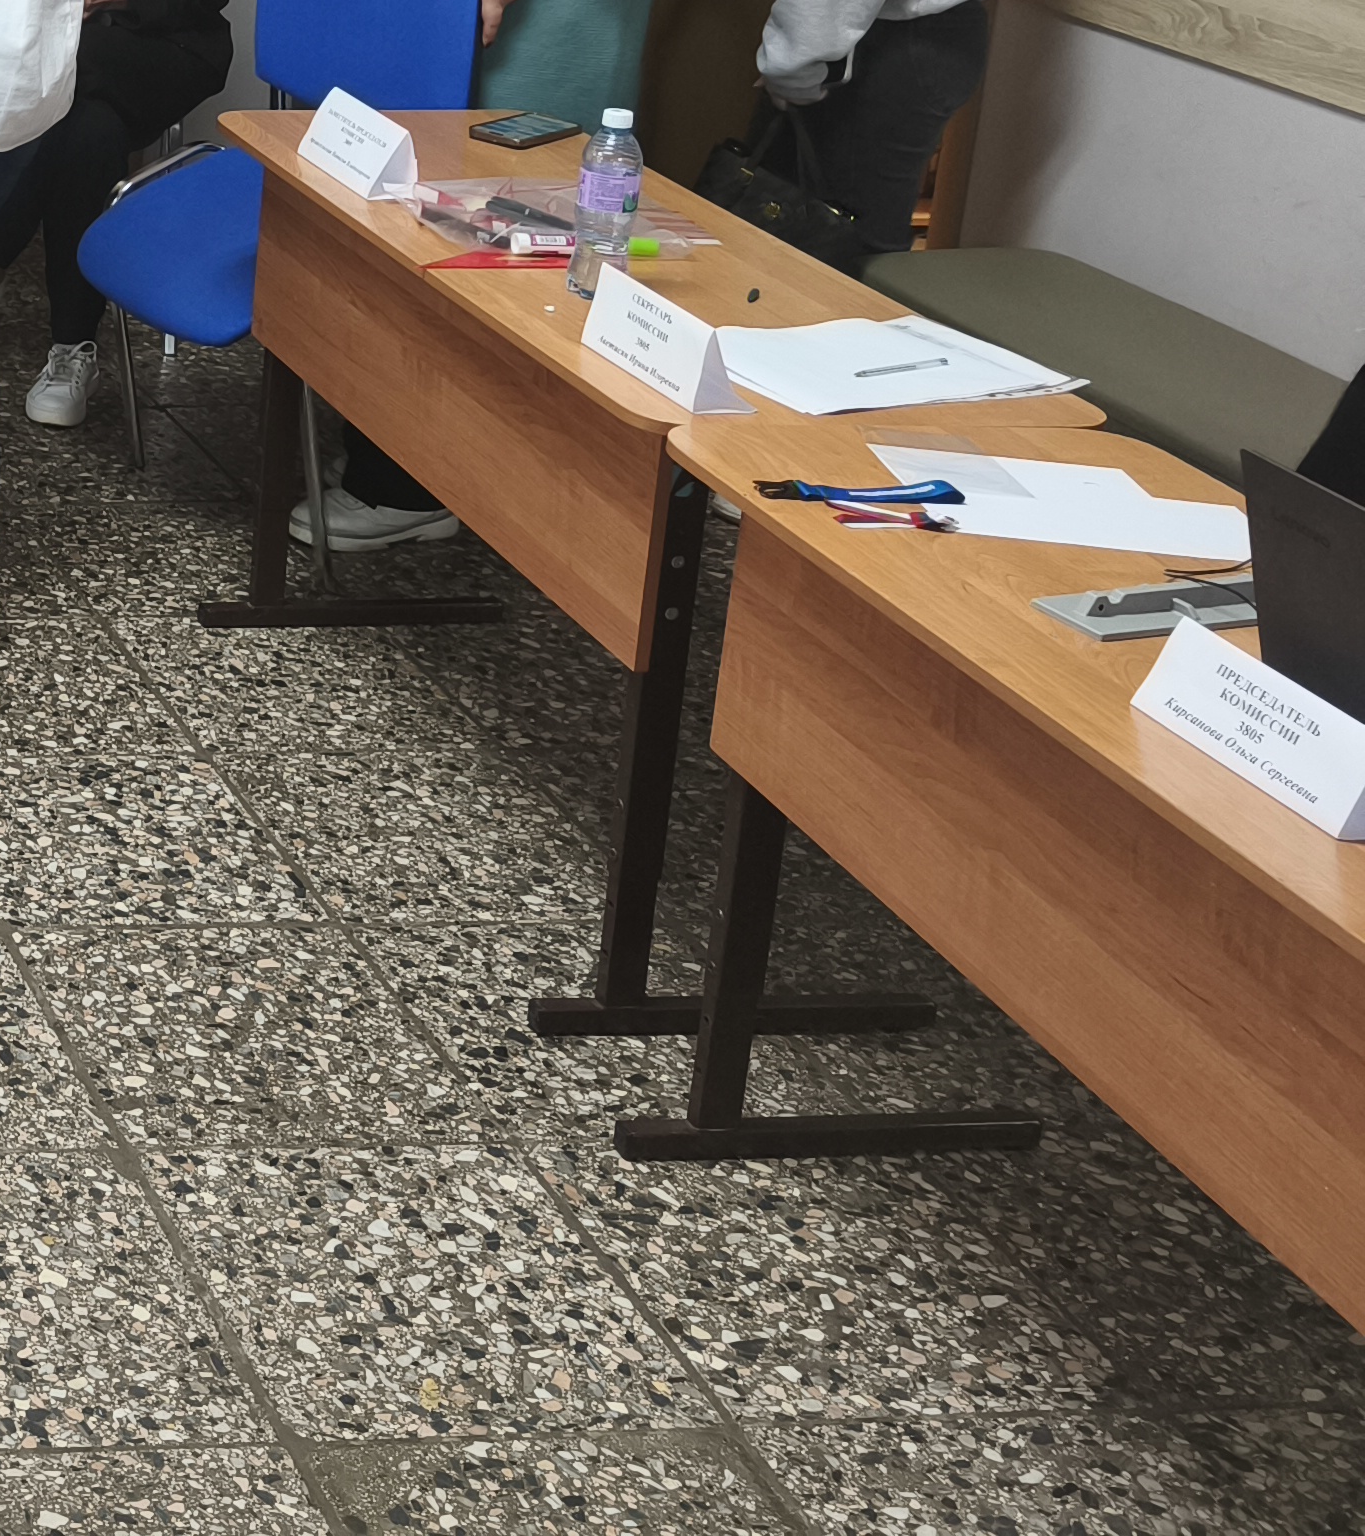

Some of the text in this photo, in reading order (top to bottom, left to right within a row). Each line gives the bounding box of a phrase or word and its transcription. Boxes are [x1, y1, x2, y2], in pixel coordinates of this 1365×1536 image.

[627, 310, 669, 343] КОМИССИИ
[632, 293, 672, 324] СЕКРЕТАРЬ
[1216, 664, 1321, 737] ПРЕДСЕДАТЕЛЬ
[1219, 687, 1301, 746] КОМИССИИ
[1164, 697, 1319, 804] Кирсанова Ольга Сергеевна
[1235, 721, 1265, 744] 3805
